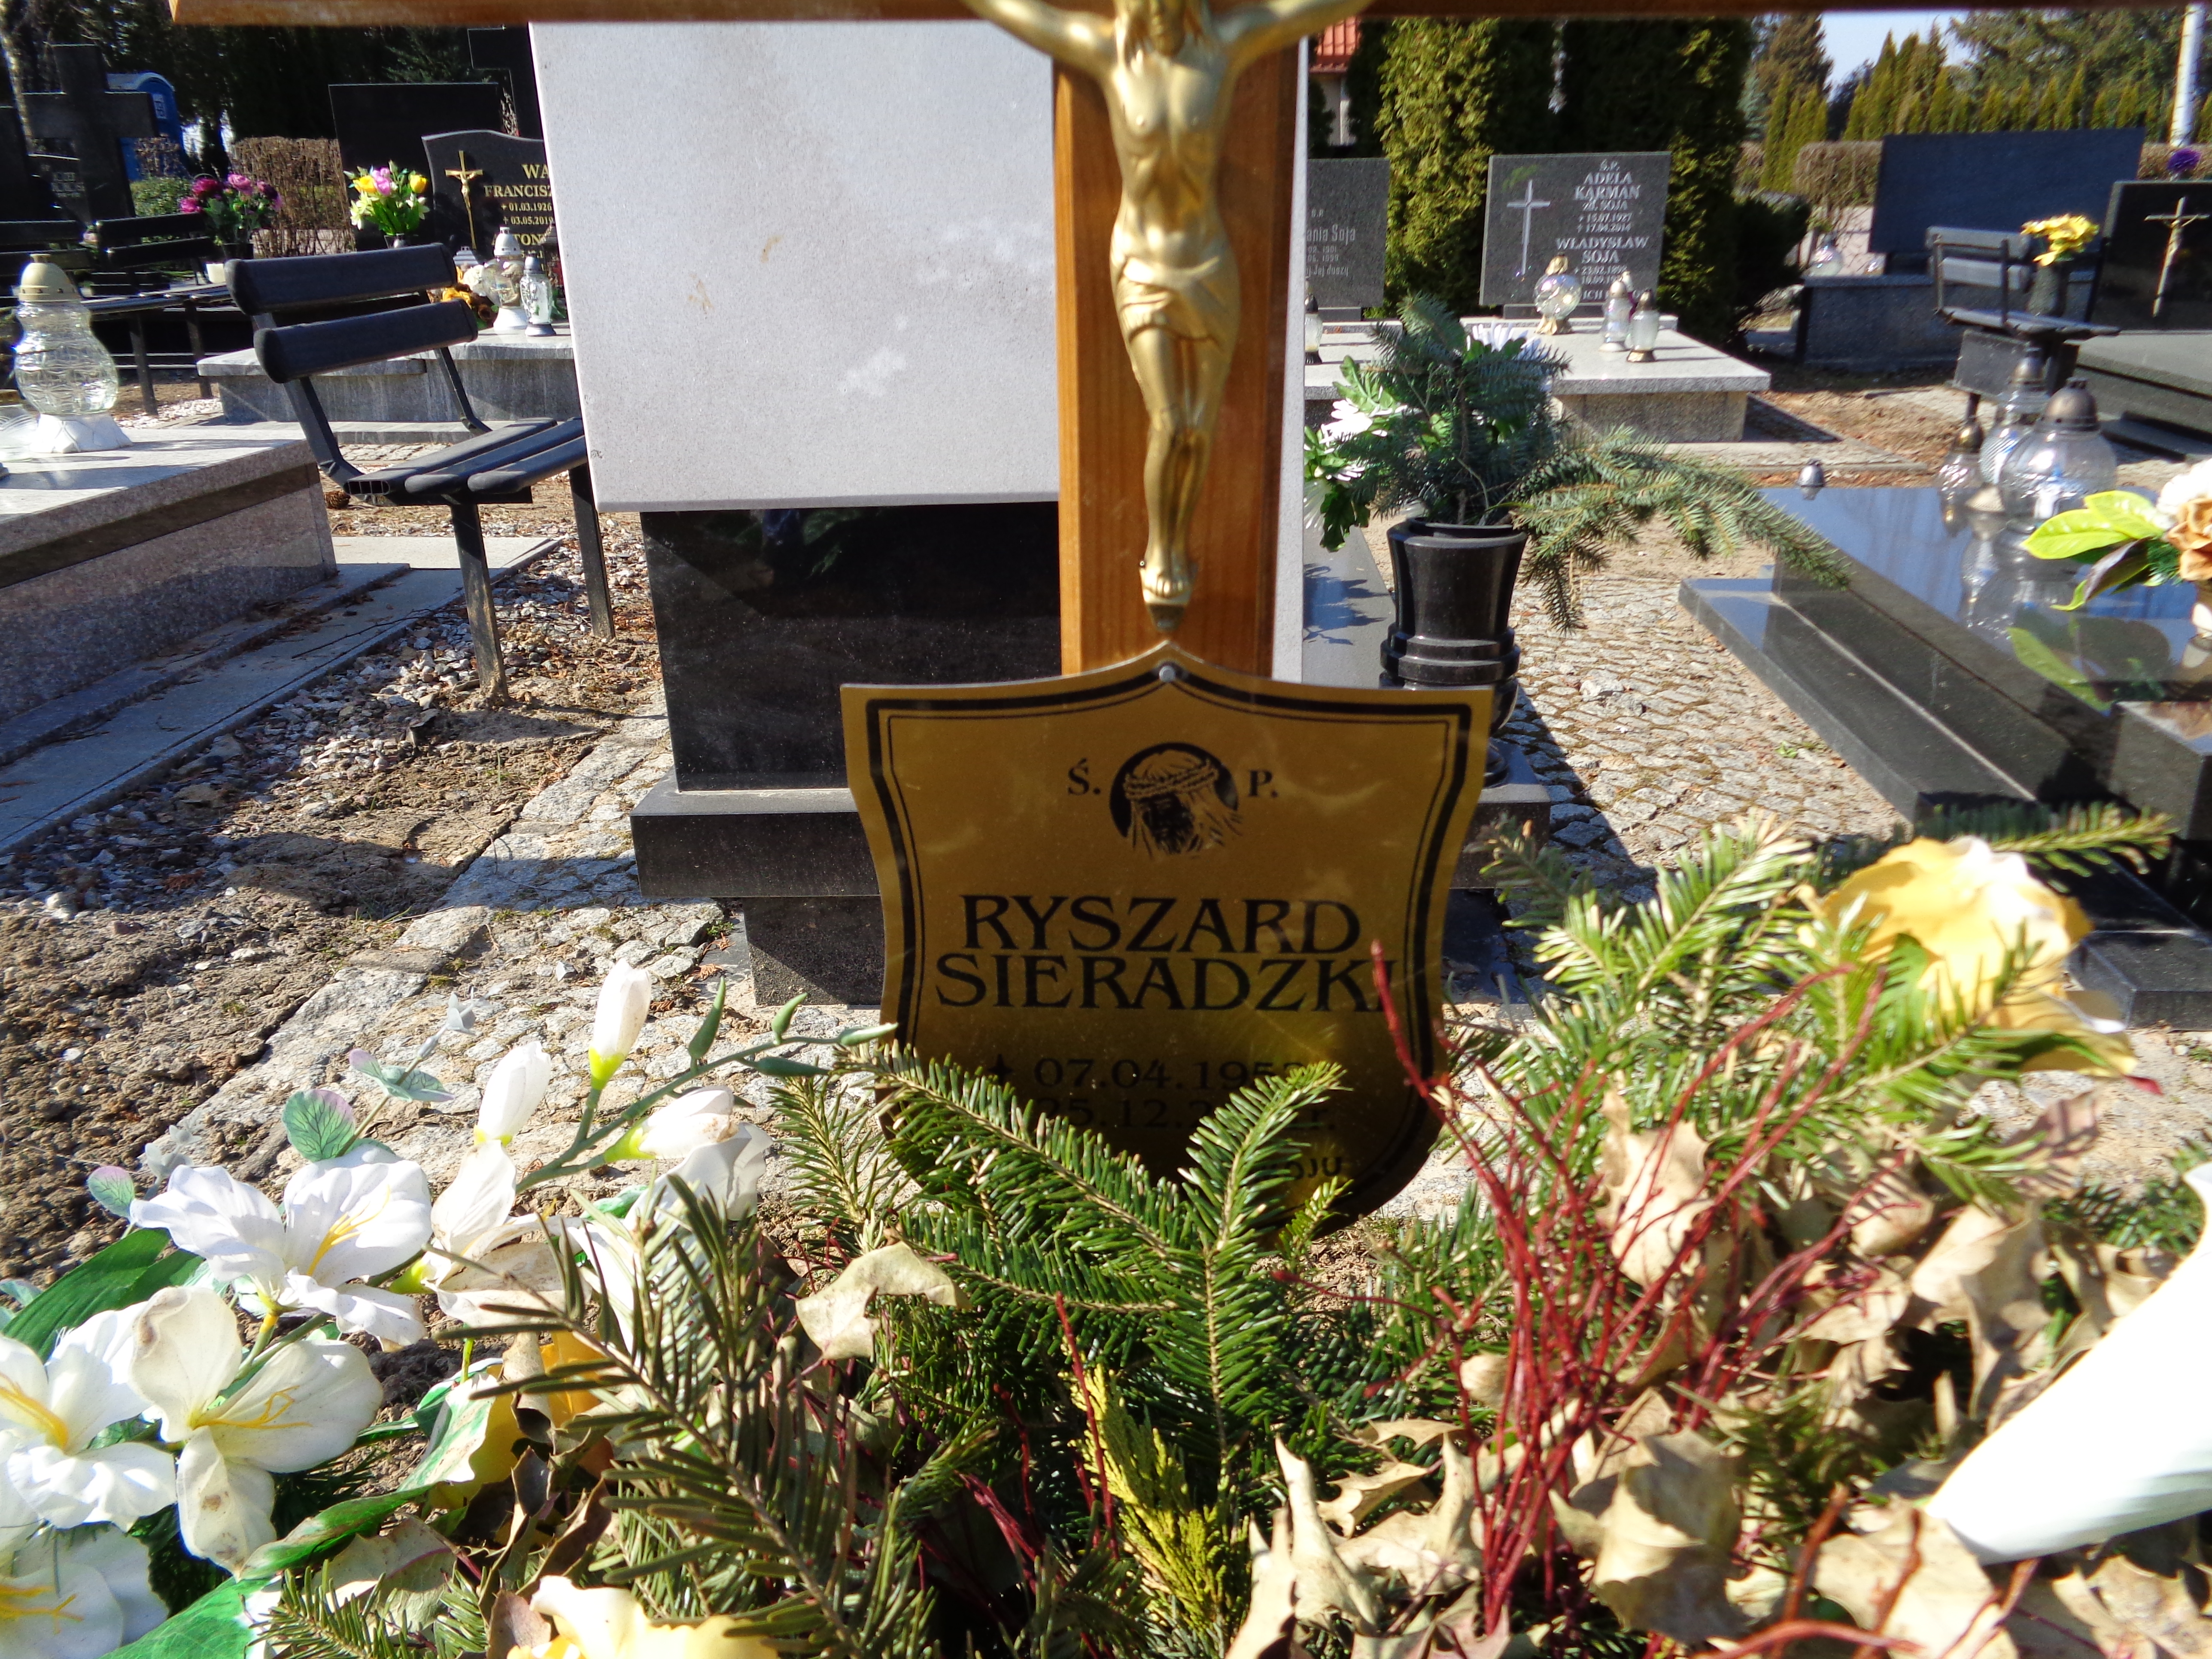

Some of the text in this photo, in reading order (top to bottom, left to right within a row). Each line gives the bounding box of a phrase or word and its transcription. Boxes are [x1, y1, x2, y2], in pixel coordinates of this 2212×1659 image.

[1583, 173, 1632, 184] ADELA
[509, 203, 552, 212] 01.03.1926
[1332, 224, 1355, 246] Soja
[1556, 237, 1649, 249] WŁADYSŁAW
[1582, 250, 1620, 263] SOJA
[1068, 758, 1278, 798] Ś. P.
[960, 894, 1361, 954] RYSZARD
[1033, 1058, 1303, 1090] 07.04.195
